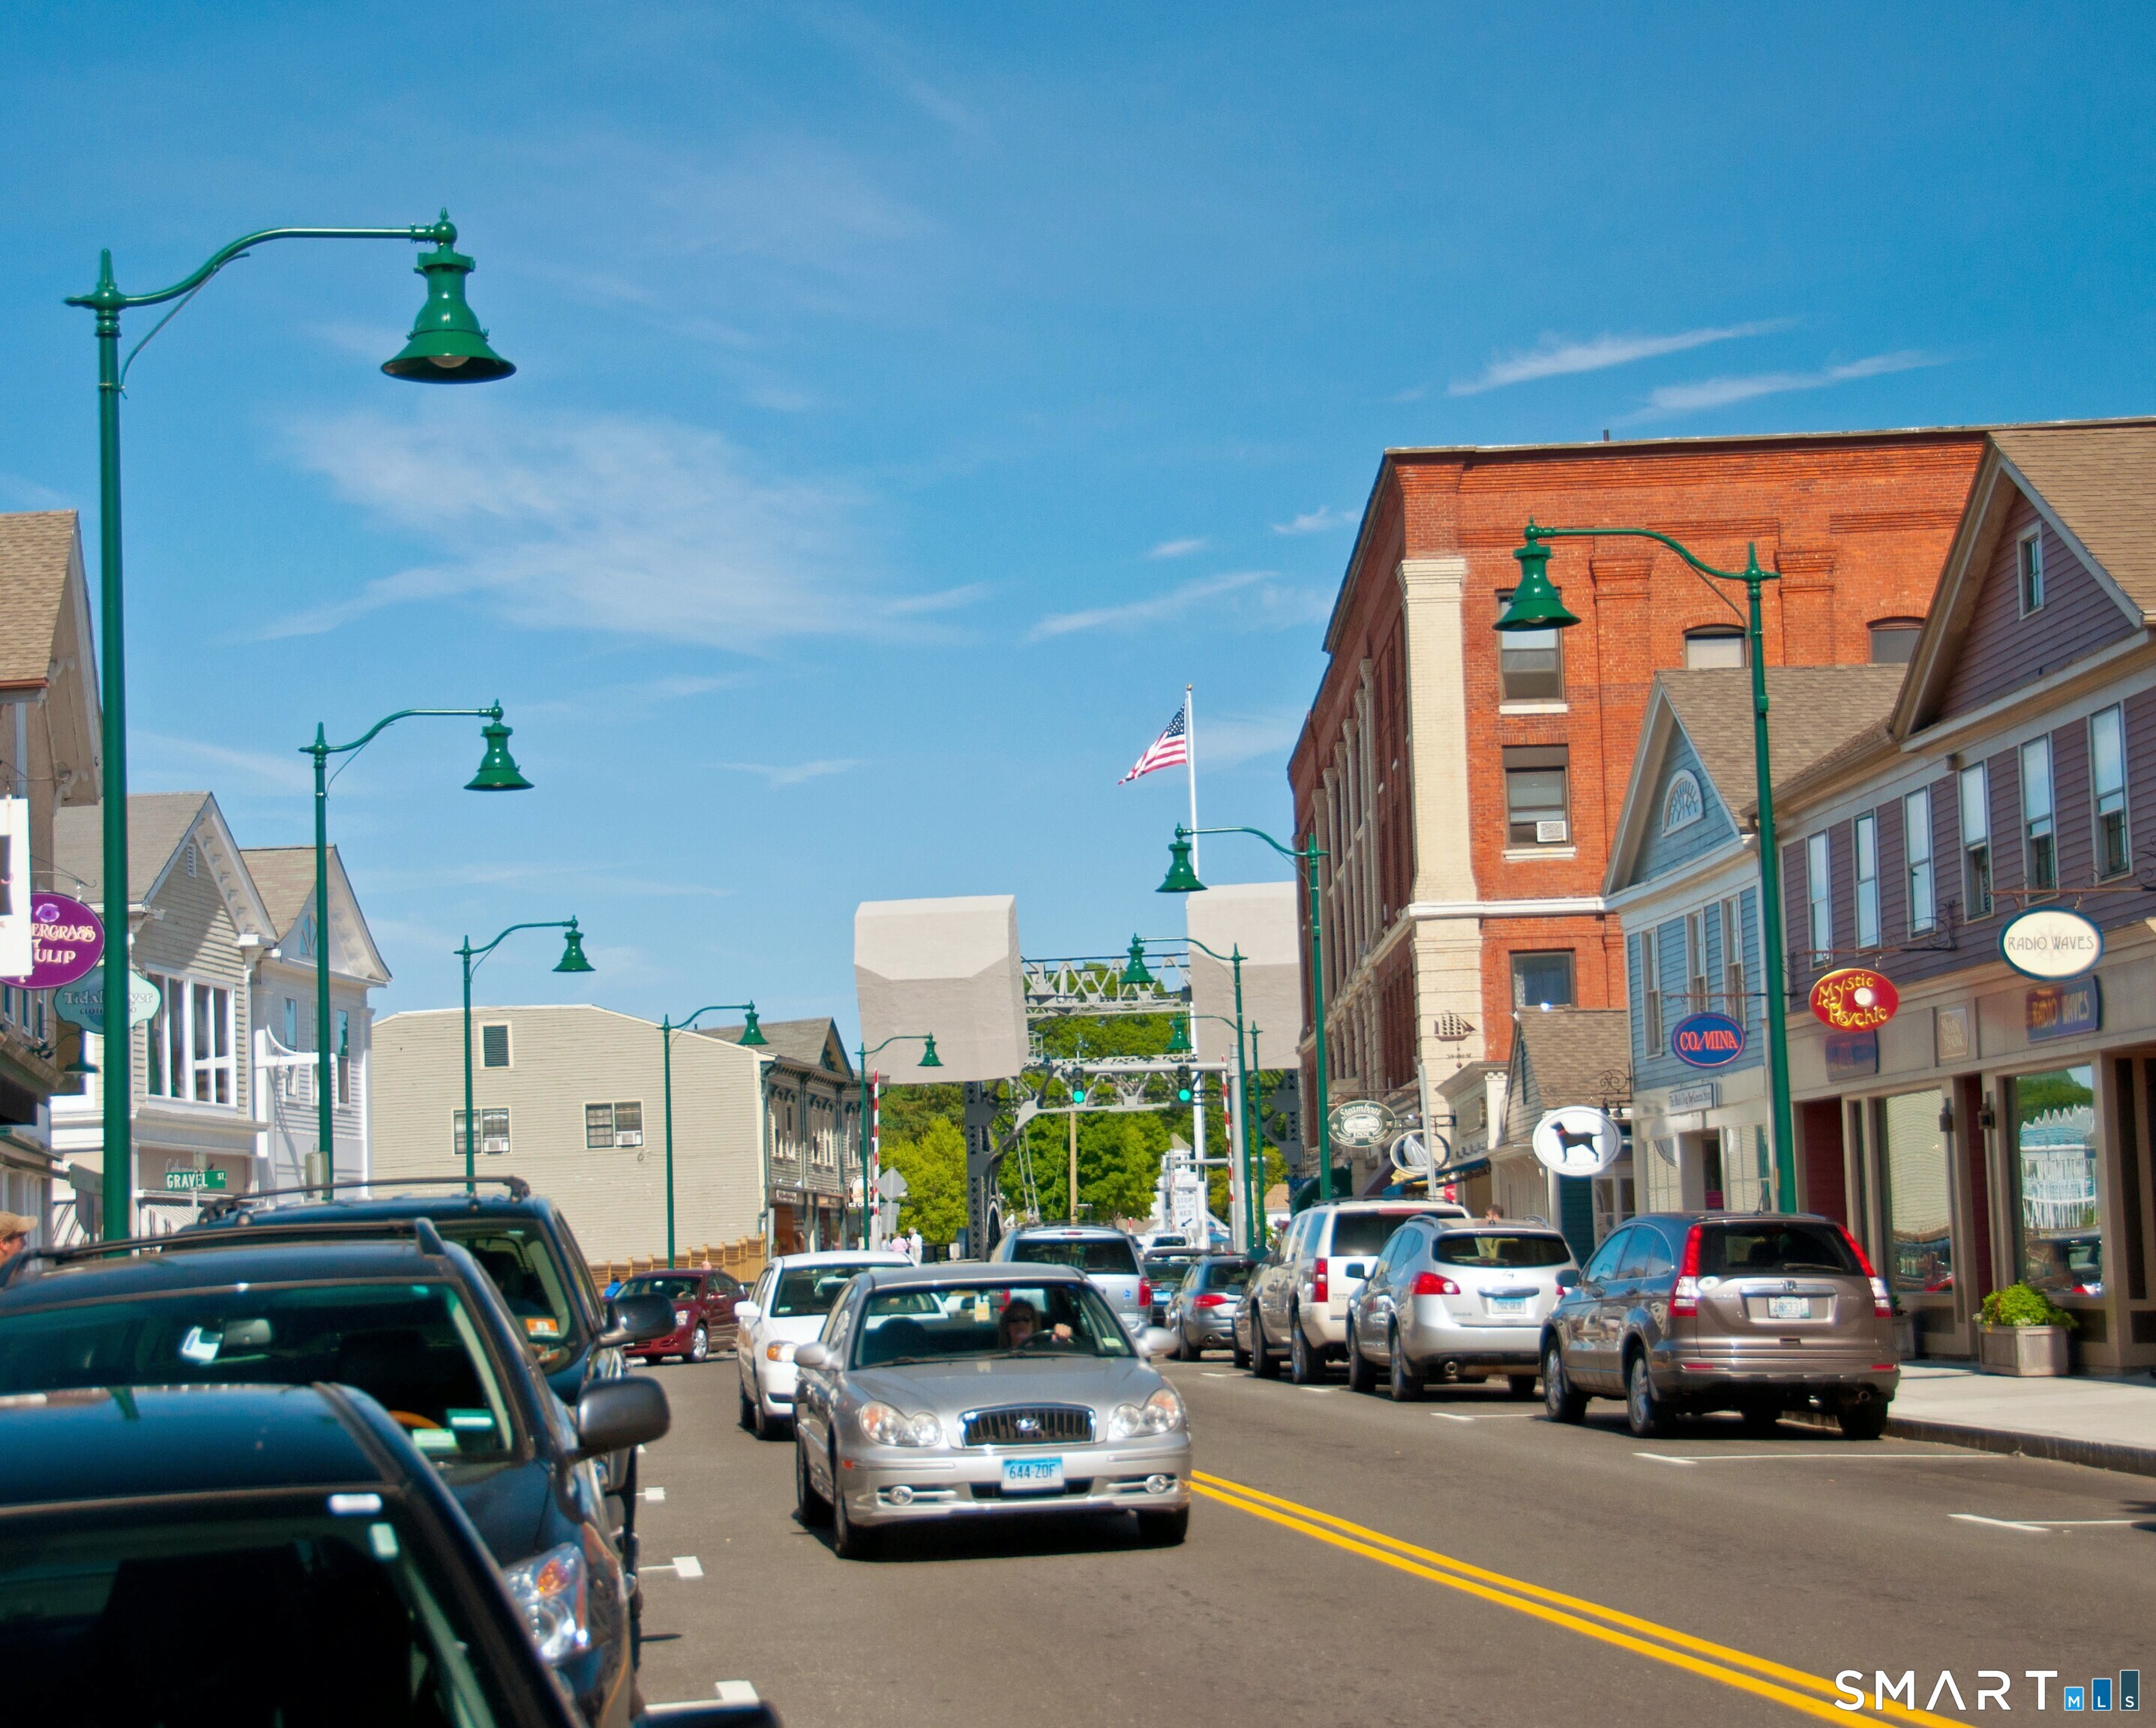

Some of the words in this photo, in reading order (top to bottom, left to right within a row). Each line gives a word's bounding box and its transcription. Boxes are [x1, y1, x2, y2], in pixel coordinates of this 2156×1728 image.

[31, 923, 96, 942] ERGRASS
[2008, 937, 2047, 950] RADIO
[2051, 936, 2094, 950] WAVES
[32, 946, 76, 964] ULIP
[63, 989, 103, 1005] Tidal
[1816, 973, 1874, 1006] Mystic
[1828, 1002, 1887, 1026] Psychic
[1680, 1030, 1739, 1051] COMINA
[1339, 1102, 1381, 1119] Steamboat
[166, 1173, 208, 1188] GRAVEL
